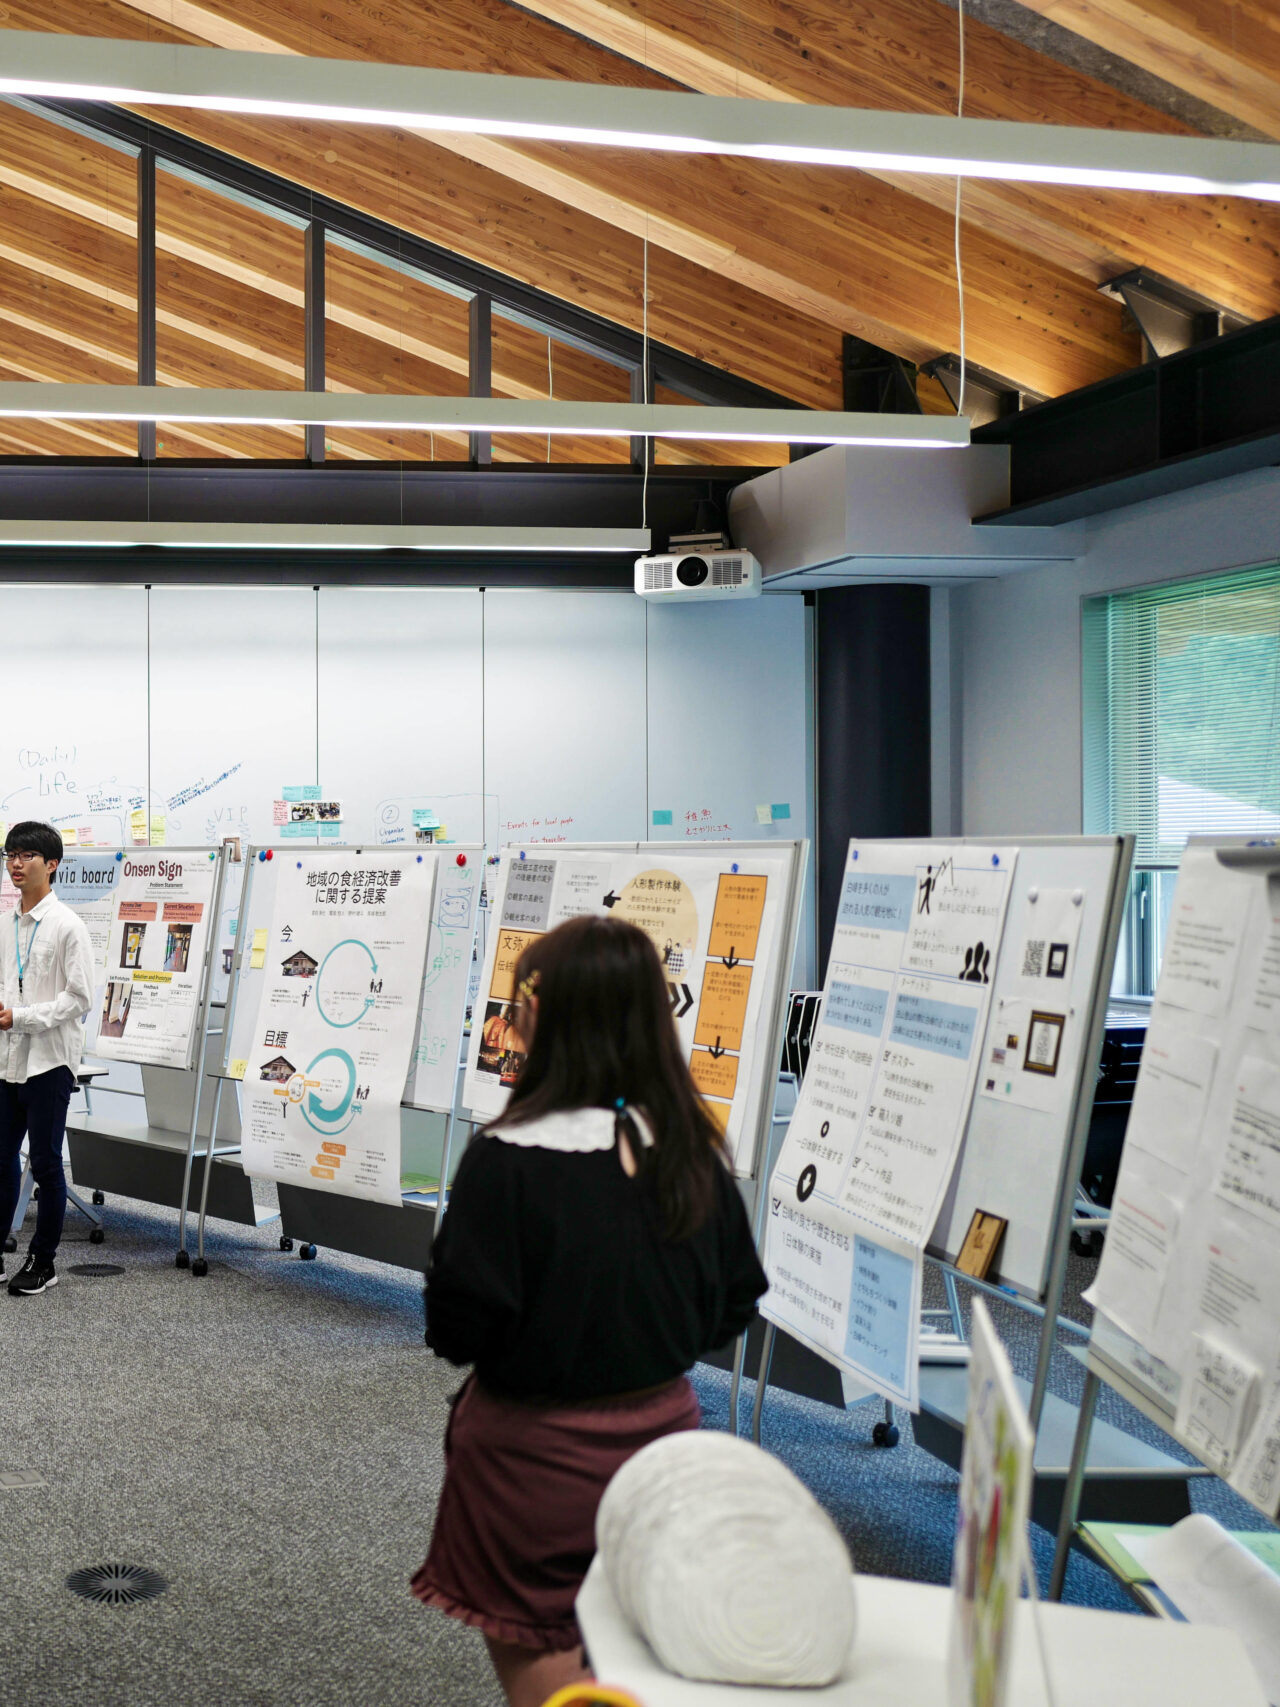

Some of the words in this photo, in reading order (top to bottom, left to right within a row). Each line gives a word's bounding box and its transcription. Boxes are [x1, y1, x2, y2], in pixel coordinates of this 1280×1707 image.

[82, 866, 114, 884] board
[123, 861, 156, 877] Onsen
[158, 859, 183, 881] Sign
[306, 870, 402, 887] 地域の食経済改善
[631, 878, 682, 892] 人形製作体験
[316, 888, 388, 905] に関する提案
[281, 924, 293, 941] 今
[264, 1030, 288, 1047] 目標
